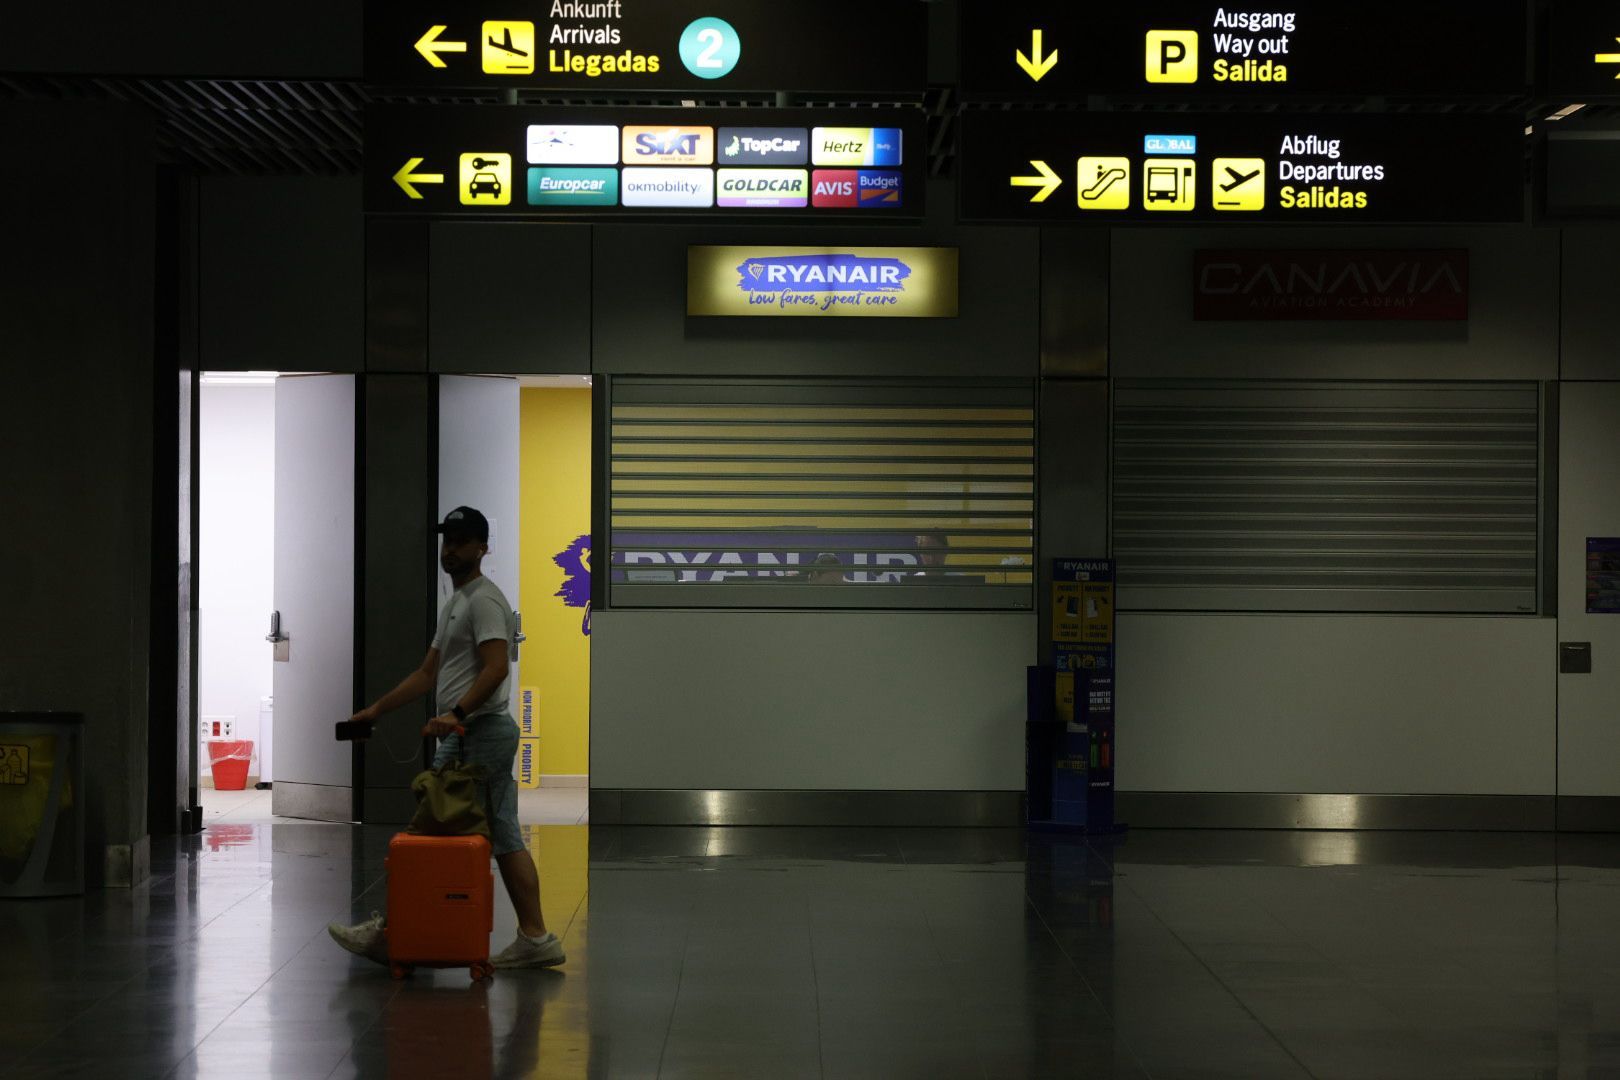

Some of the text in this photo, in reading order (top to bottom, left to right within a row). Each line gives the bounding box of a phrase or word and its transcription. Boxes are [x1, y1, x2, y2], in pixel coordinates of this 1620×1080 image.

[550, 0, 622, 19] Ankunft
[1213, 8, 1296, 32] Ausgang
[550, 24, 621, 44] Arrivals
[696, 28, 724, 68] 2
[1213, 33, 1289, 57] Way out
[549, 49, 660, 77] Llegadas
[1160, 40, 1186, 75] P
[1213, 59, 1287, 82] Salida
[741, 137, 801, 155] TopCar
[823, 140, 863, 153] Hertz
[1147, 139, 1193, 150] GLBAL
[1280, 135, 1341, 158] Abflug
[1279, 161, 1384, 183] Departures
[540, 176, 606, 193] Europcar
[723, 178, 802, 192] GOLDCAR
[814, 181, 853, 195] AVIS
[860, 176, 898, 189] Budget
[1280, 186, 1368, 208] Salidas
[767, 264, 900, 283] RYANAIR
[1200, 262, 1463, 294] CANAVIA
[820, 291, 863, 310] great
[866, 294, 898, 305] care
[1063, 562, 1109, 571] RYANAIR
[521, 744, 532, 784] PRIORITY
